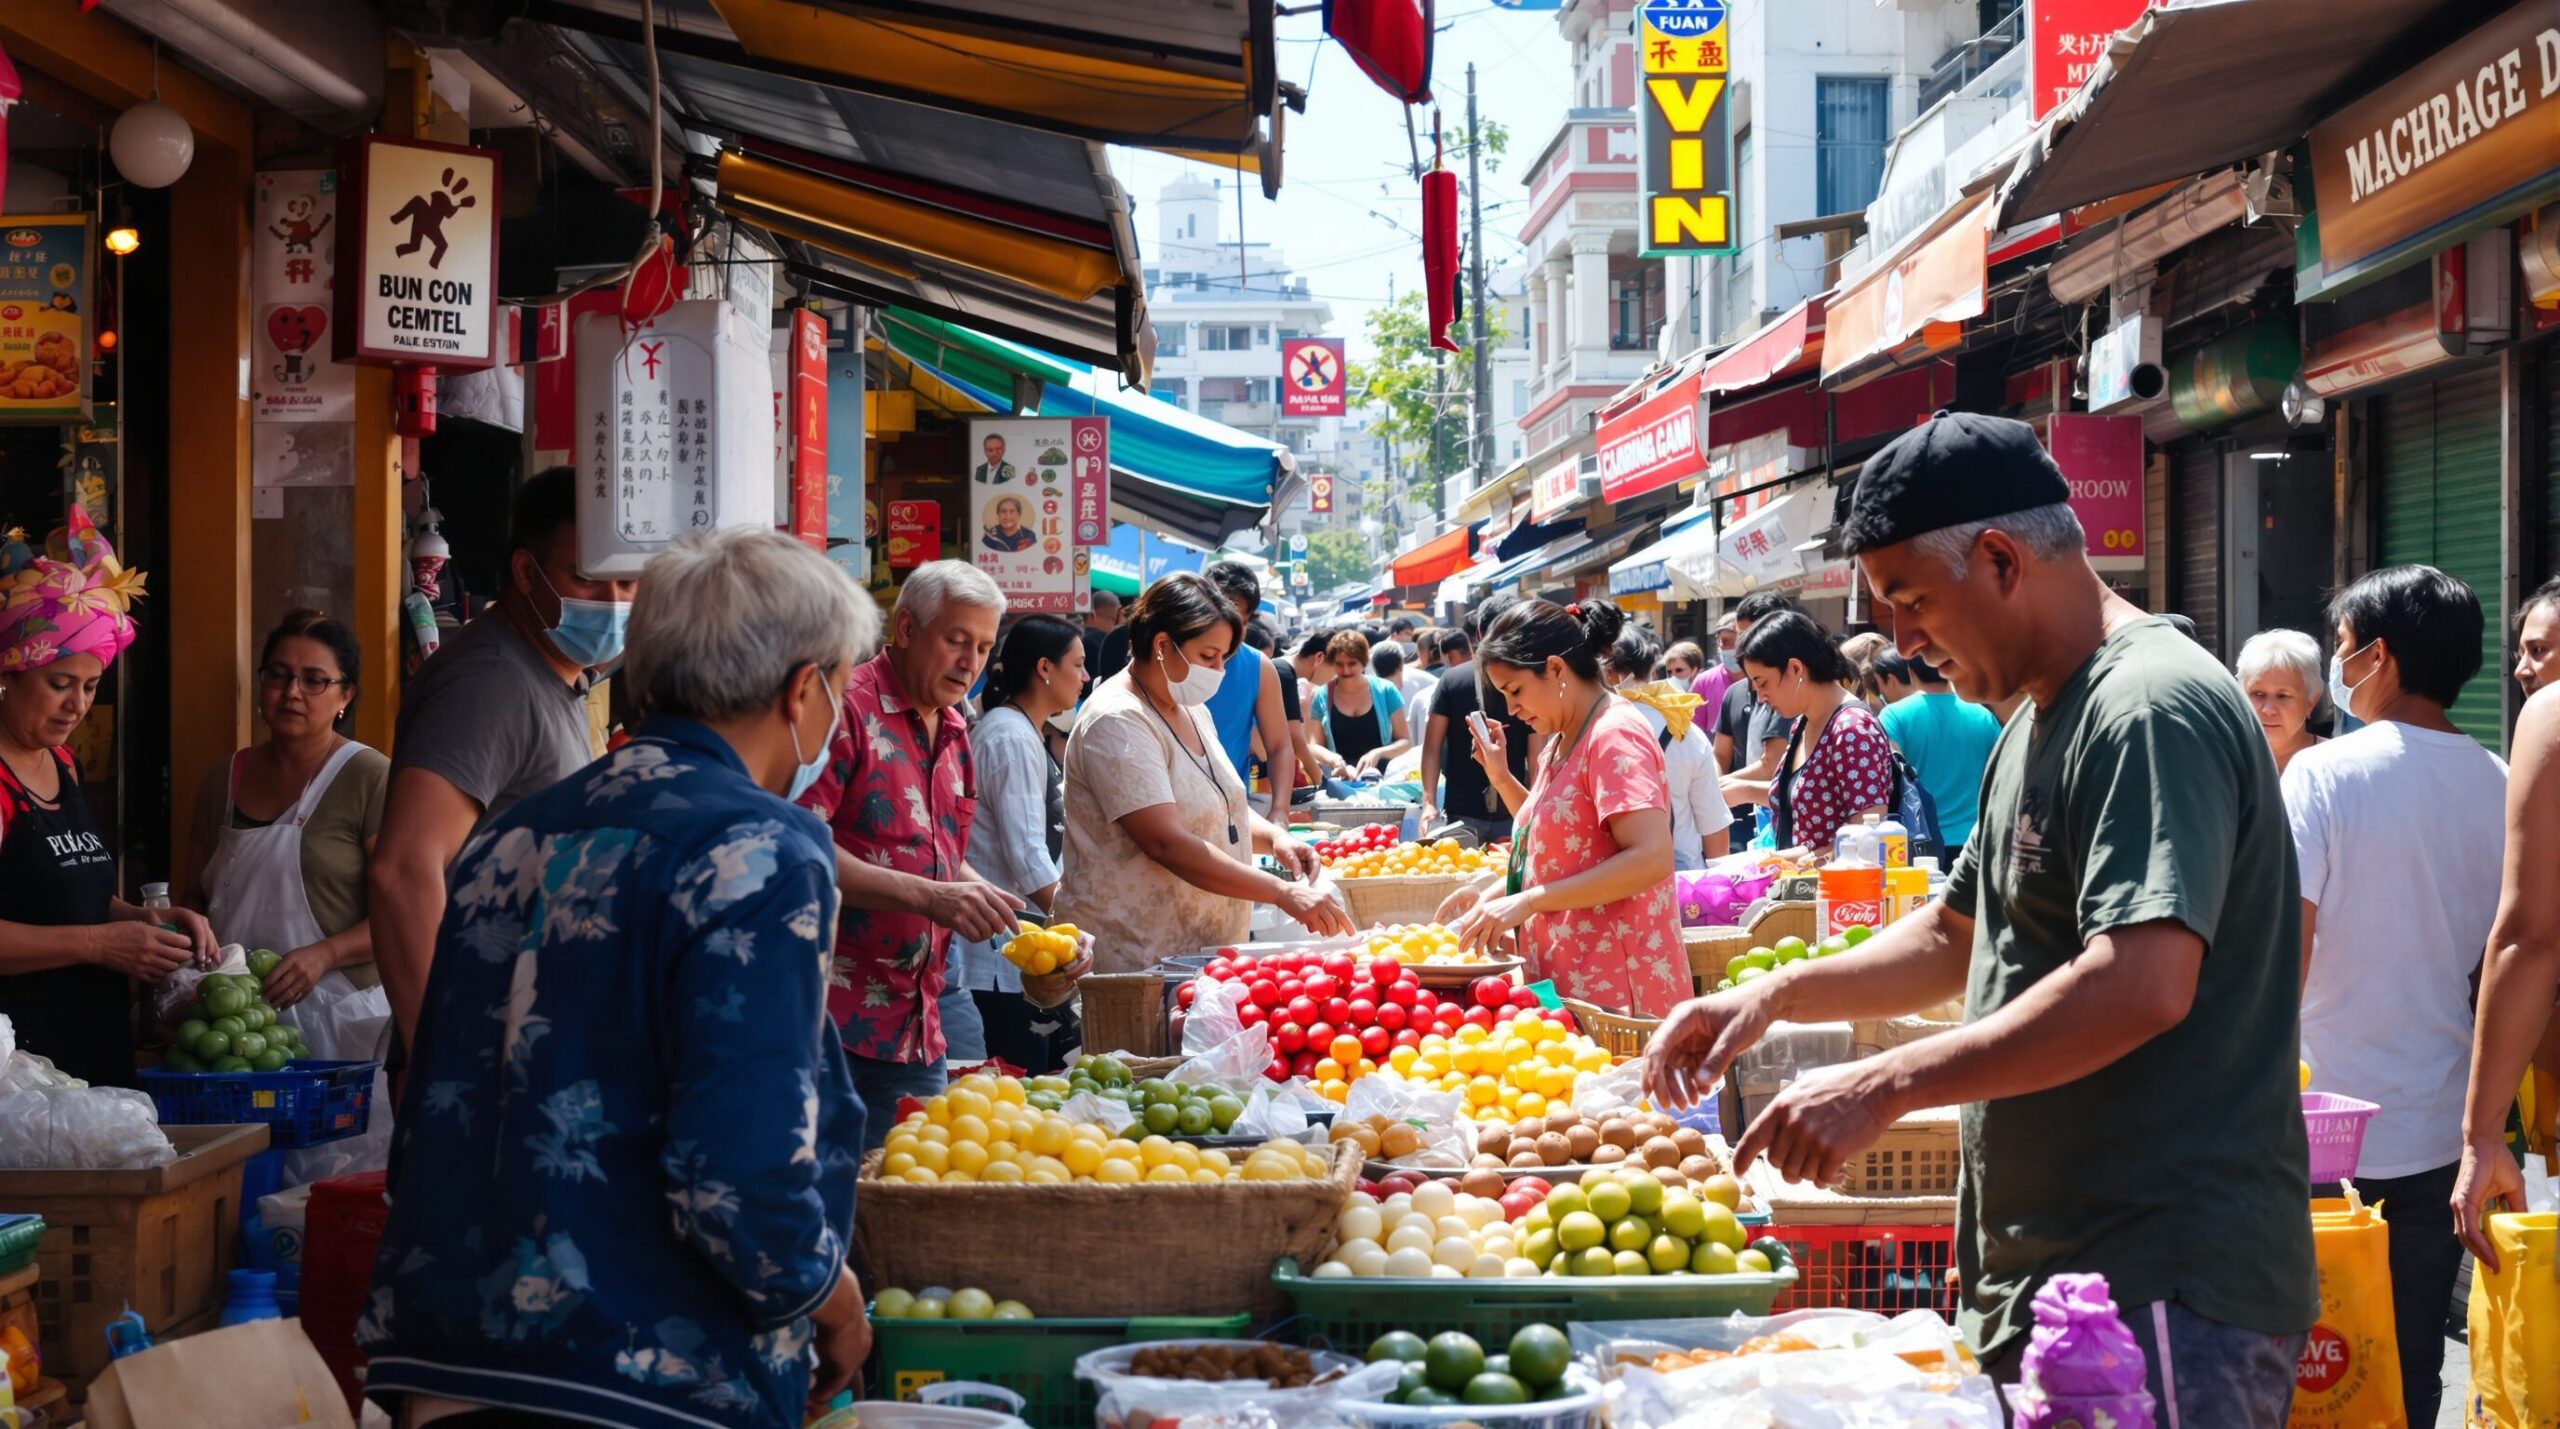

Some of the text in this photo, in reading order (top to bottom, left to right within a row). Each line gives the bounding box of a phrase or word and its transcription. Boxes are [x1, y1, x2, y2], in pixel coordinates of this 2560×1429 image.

[1659, 15, 1709, 30] FUAN
[2345, 47, 2527, 203] MACHRAGE
[379, 274, 472, 306] BUN CON
[387, 305, 467, 335] CEMTEL
